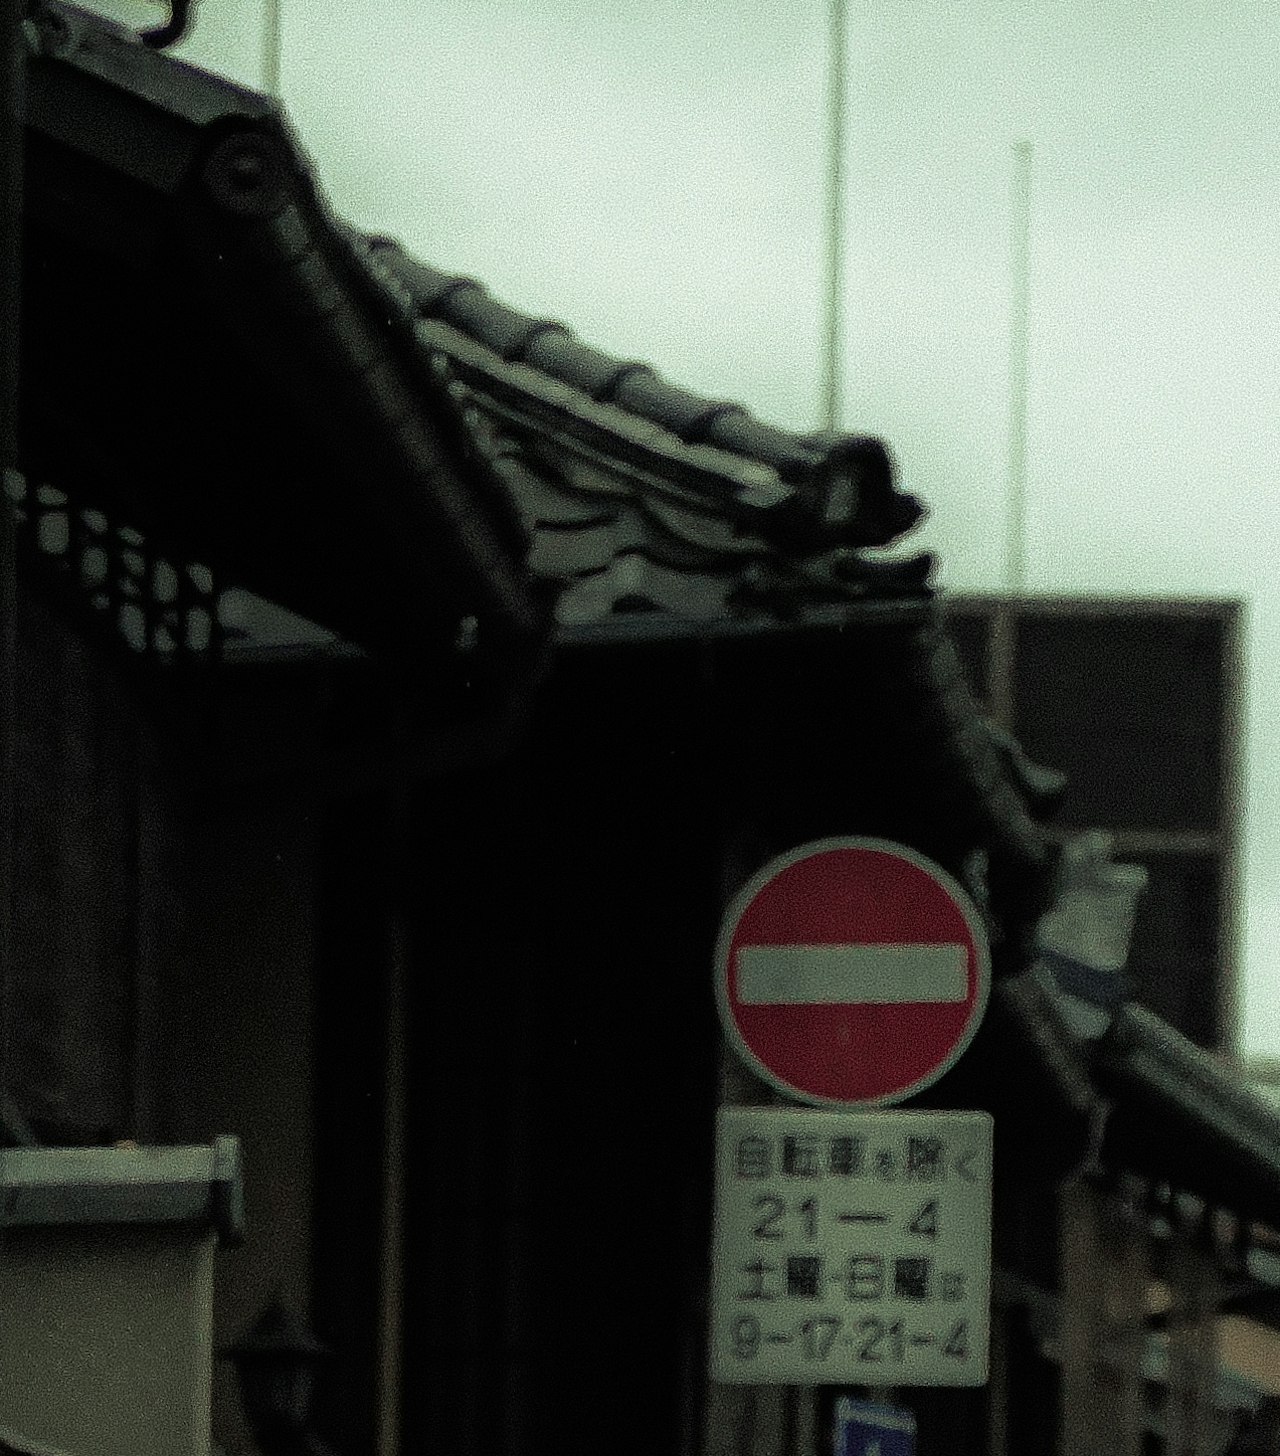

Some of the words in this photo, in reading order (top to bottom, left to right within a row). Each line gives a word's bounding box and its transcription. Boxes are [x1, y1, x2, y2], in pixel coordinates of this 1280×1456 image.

[735, 1135, 979, 1182] 自転車を除く
